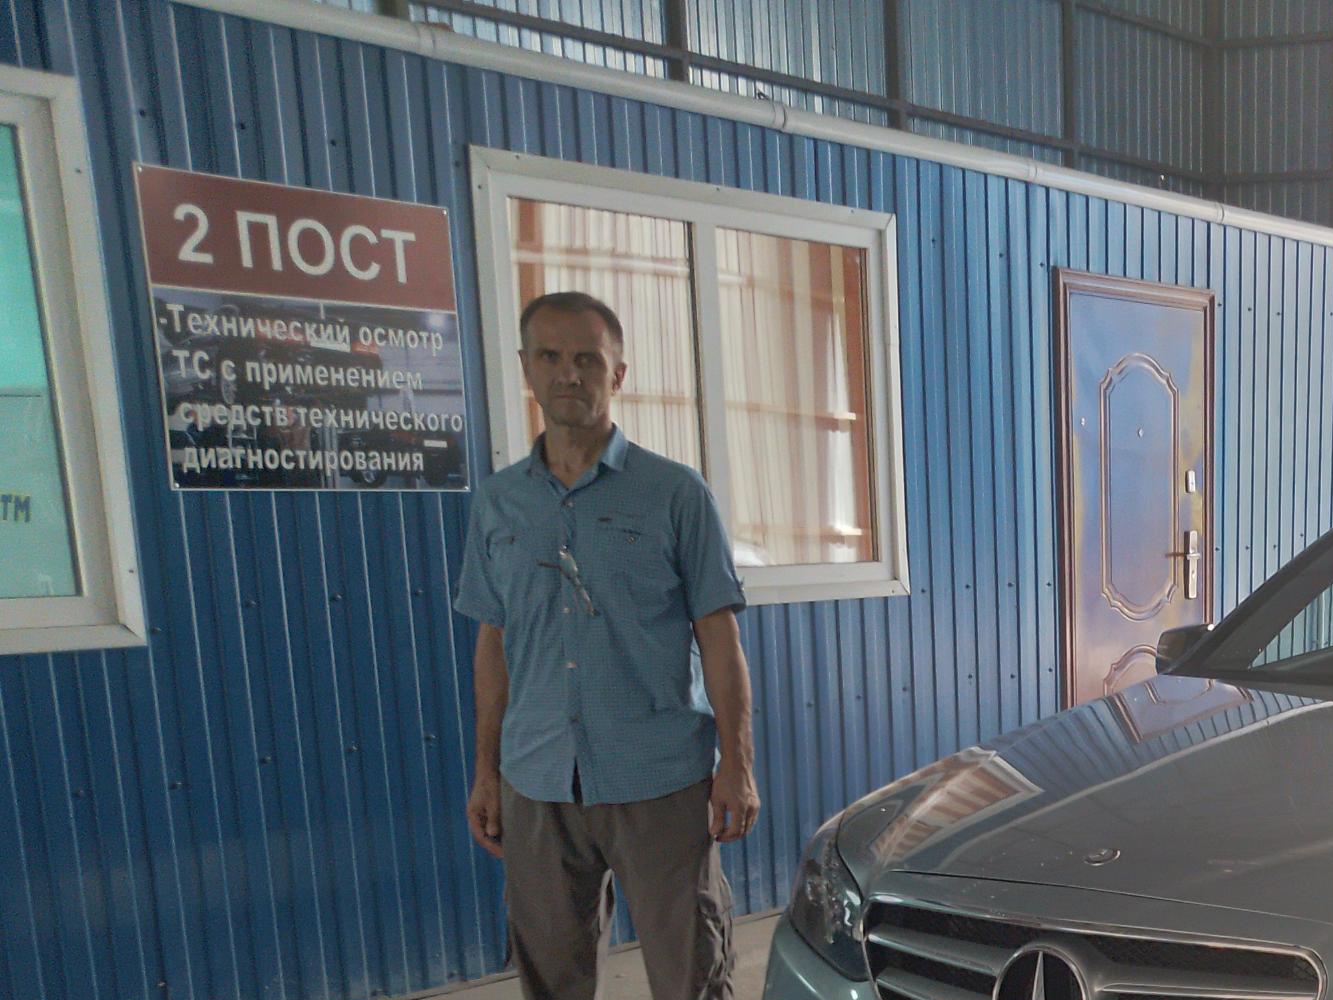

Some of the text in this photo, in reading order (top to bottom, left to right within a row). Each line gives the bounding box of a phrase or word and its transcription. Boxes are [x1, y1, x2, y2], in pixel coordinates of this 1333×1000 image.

[173, 203, 416, 284] 2 ПОСТ
[159, 303, 443, 357] -Технический осмотр
[172, 350, 423, 390] ТС с применением
[178, 402, 463, 432] средств технического
[182, 447, 425, 477] диагностирования
